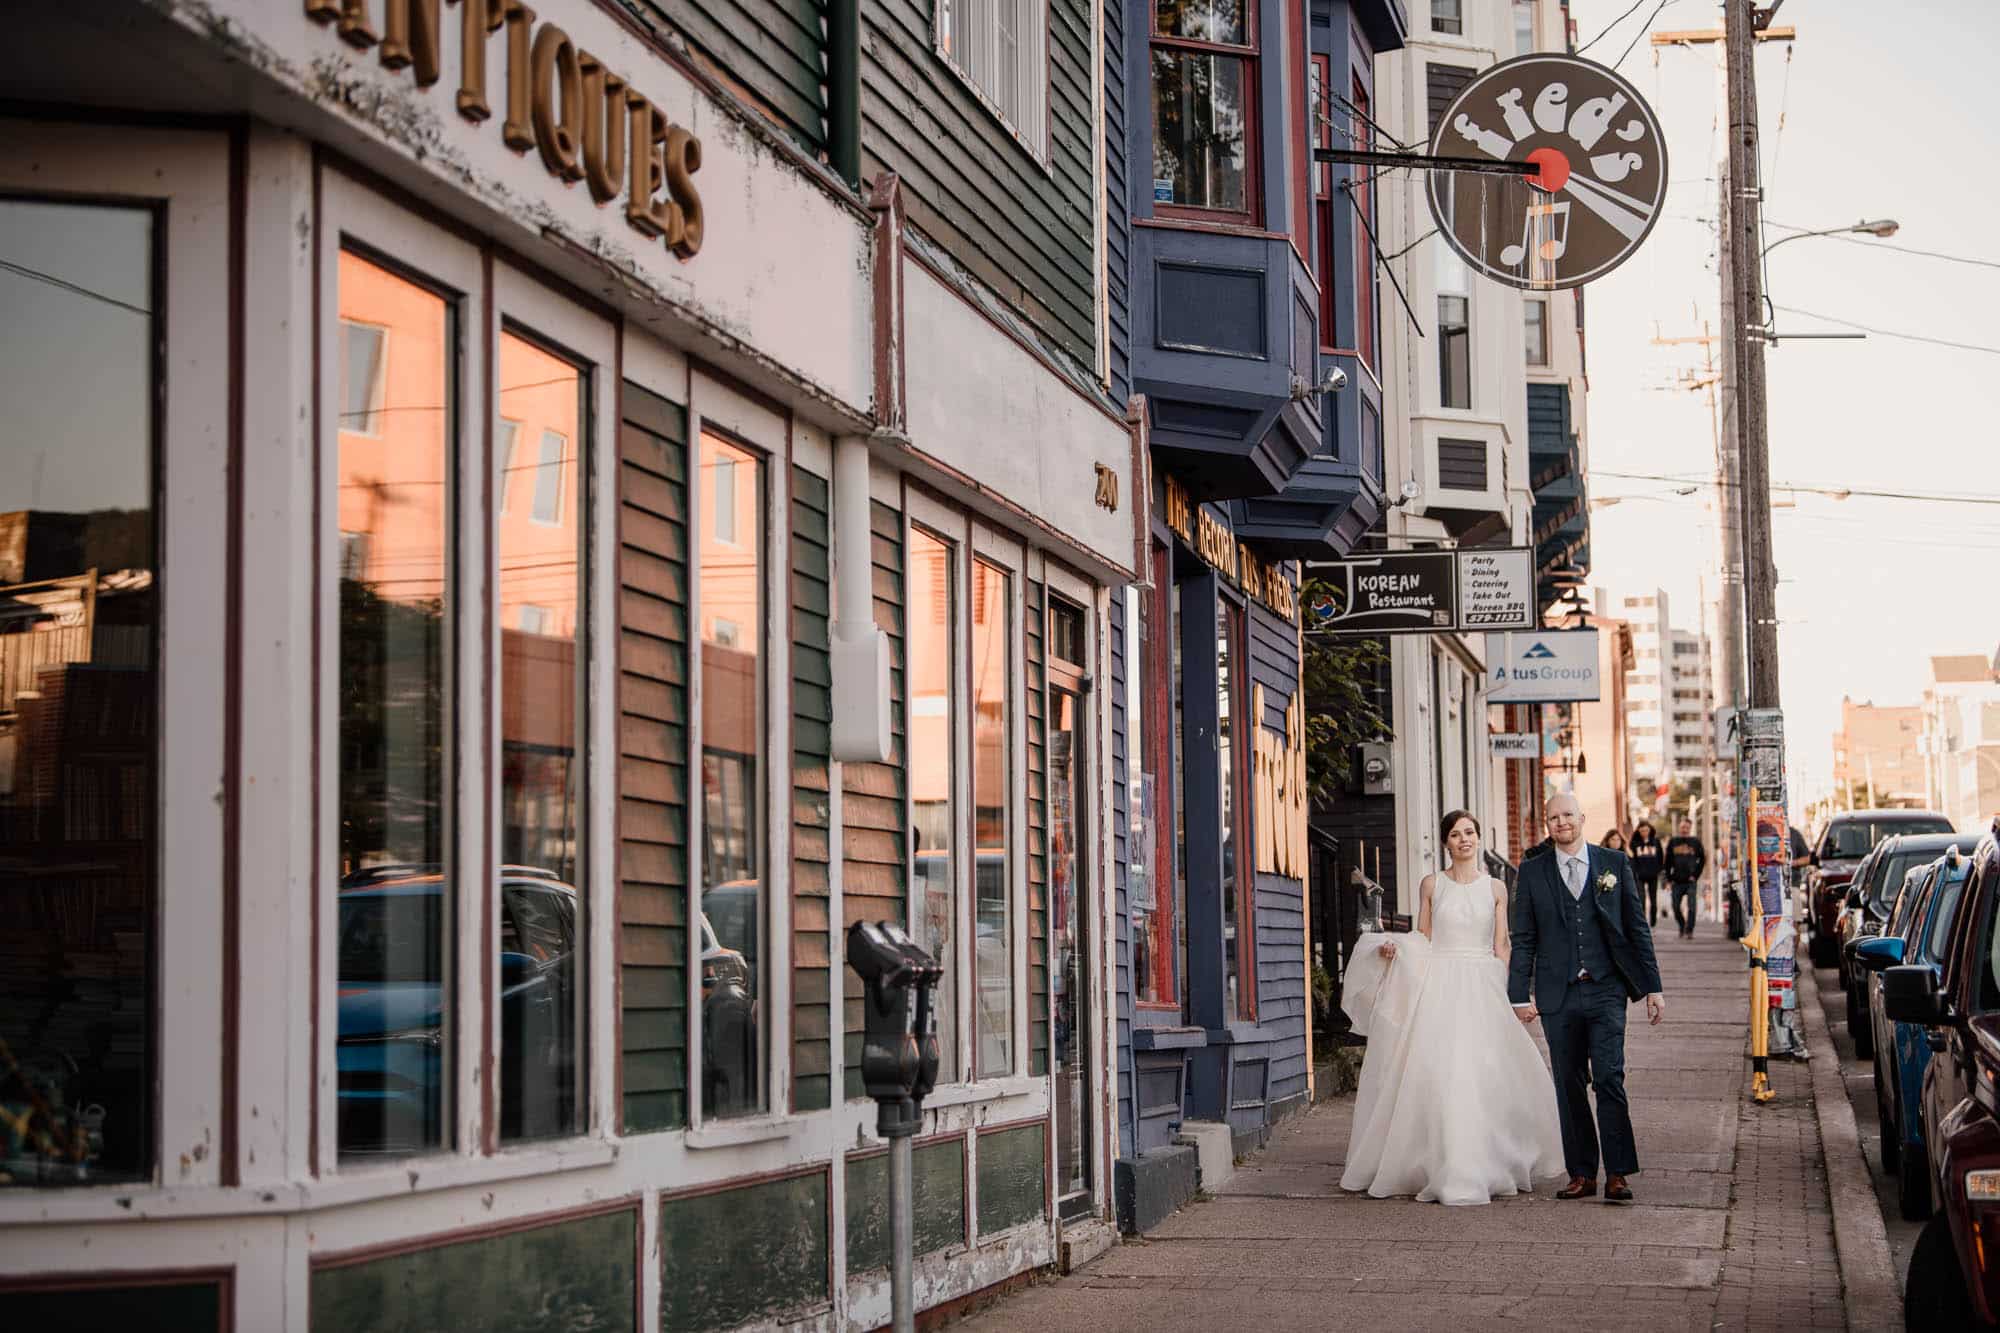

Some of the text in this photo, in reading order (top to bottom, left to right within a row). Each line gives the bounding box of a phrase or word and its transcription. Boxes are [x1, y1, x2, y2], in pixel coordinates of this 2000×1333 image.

[305, 0, 704, 262] NTIQUES
[1198, 504, 1237, 579] RECORD
[1471, 556, 1495, 567] Party
[1471, 568, 1500, 578] Dining
[1358, 574, 1420, 593] KOREAN
[1471, 580, 1509, 589] Catering
[1368, 593, 1435, 608] Restaurant
[1472, 591, 1512, 600] Take Out
[1472, 602, 1525, 612] Korean BBQ
